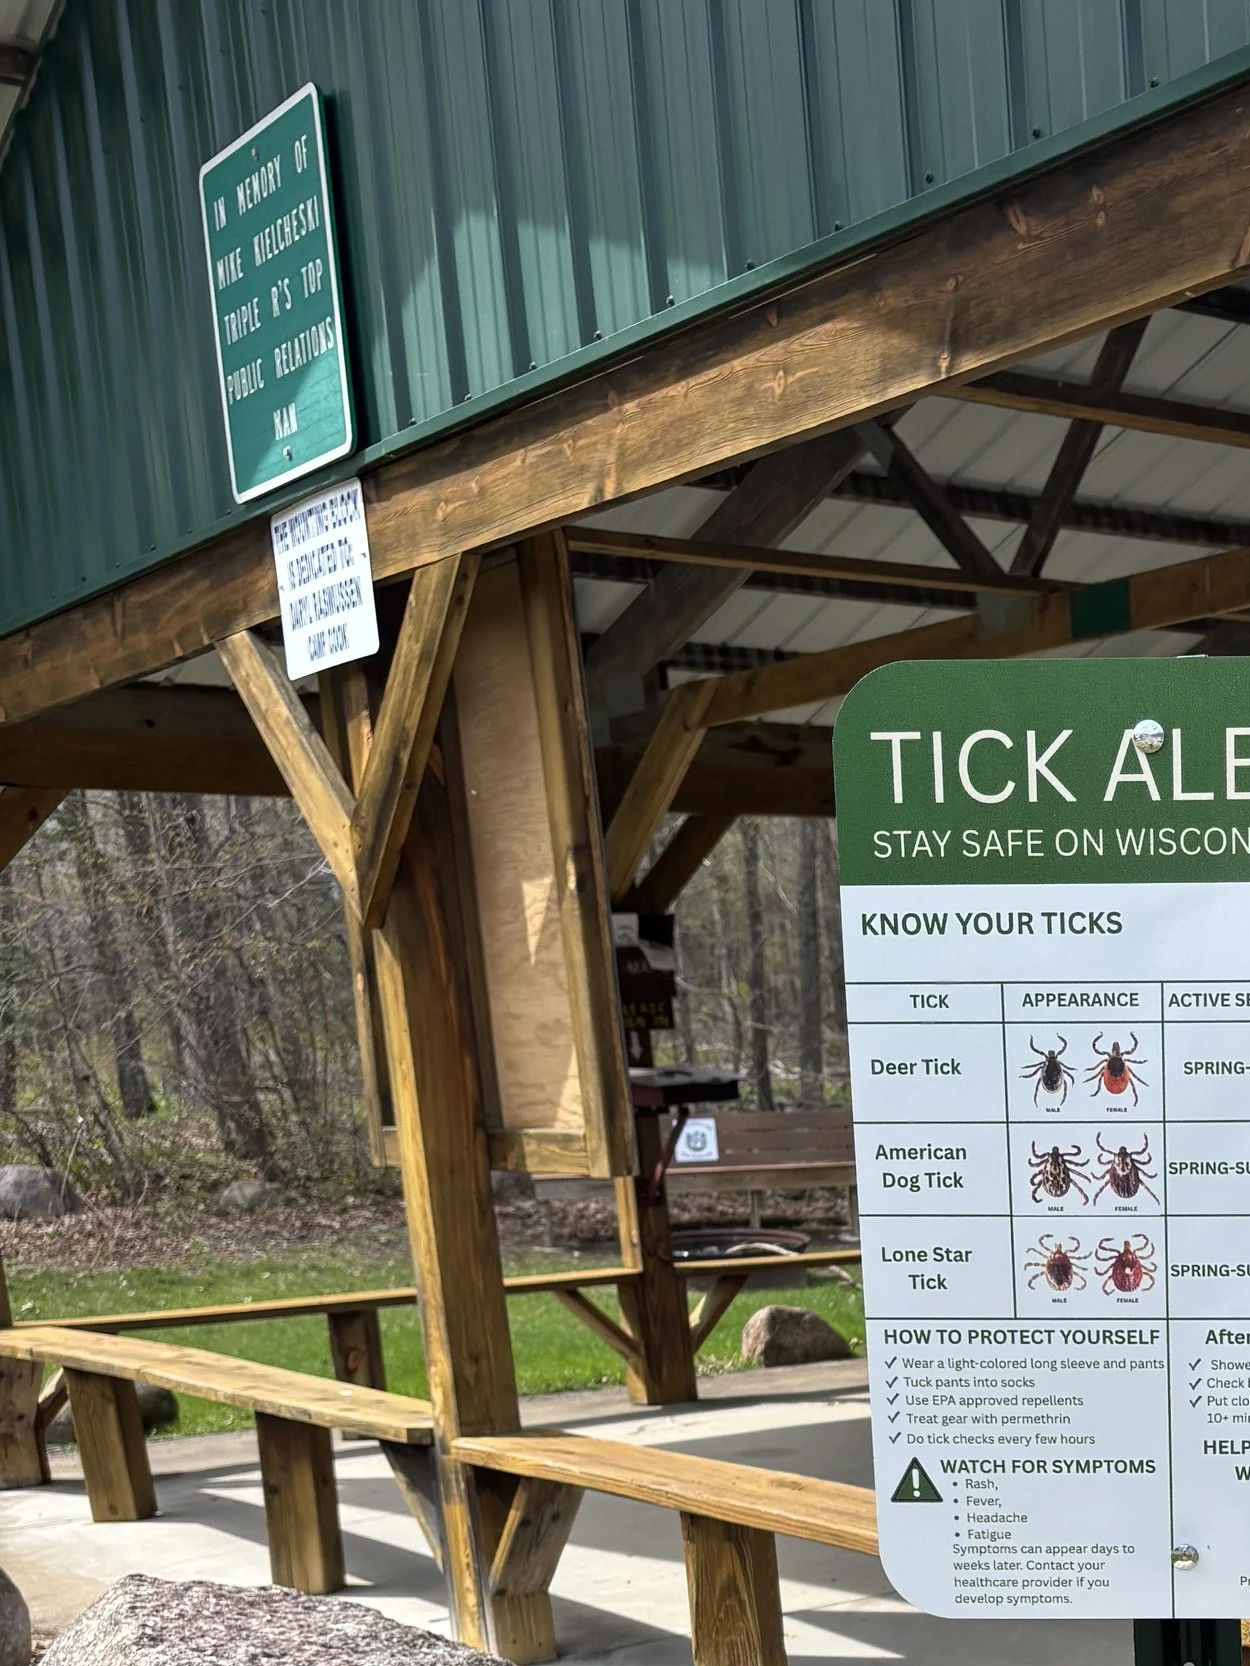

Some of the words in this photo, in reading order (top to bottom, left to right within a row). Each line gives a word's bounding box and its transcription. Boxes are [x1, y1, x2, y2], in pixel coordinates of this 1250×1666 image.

[214, 196, 227, 231] IN
[236, 154, 281, 216] MEMORY
[294, 134, 308, 174] OF
[216, 247, 243, 290] MIKE
[252, 195, 320, 267] KIELCHESKI
[224, 297, 261, 345] TRIPLE
[300, 258, 323, 298] TOP
[226, 358, 265, 405] PUBLIC
[274, 316, 335, 379] RELATIONS
[273, 402, 298, 440] MAN
[869, 729, 1078, 804] TICK
[873, 829, 952, 859] STAY
[962, 829, 1045, 858] SAFE
[1055, 828, 1104, 857] ON
[861, 912, 949, 936] KNOW
[954, 911, 1035, 936] YOUR
[1040, 911, 1123, 935] TICKS
[909, 993, 950, 1009] TICK
[1021, 992, 1140, 1008] APPEARANCE
[1167, 992, 1231, 1008] ACTIVE
[870, 1058, 918, 1076] Deer
[920, 1057, 962, 1076] Tick
[874, 1143, 967, 1161] American
[882, 1172, 921, 1193] Dog
[923, 1171, 965, 1189] Tick
[881, 1246, 928, 1263] Lone
[932, 1246, 973, 1263] Star
[907, 1273, 948, 1290] Tick
[883, 1328, 932, 1345] HOW
[935, 1329, 962, 1345] TO
[967, 1329, 1056, 1345] PROTECT
[1059, 1329, 1161, 1345] YOURSELF
[901, 1357, 935, 1369] Wear
[937, 1359, 946, 1369] a
[947, 1357, 1028, 1372] light-colored
[1030, 1357, 1058, 1372] long
[1060, 1357, 1101, 1370] sleeve
[1102, 1357, 1127, 1370] and
[1129, 1359, 1165, 1372] pants
[902, 1376, 933, 1388] Tuck
[935, 1377, 971, 1391] pants
[973, 1376, 998, 1388] into
[1000, 1376, 1036, 1388] socks
[1206, 1377, 1245, 1389] Check
[905, 1394, 930, 1406] Use
[932, 1394, 957, 1406] EPA
[958, 1394, 1019, 1409] approved
[1021, 1394, 1084, 1409] repellents
[1207, 1395, 1229, 1407] Put
[905, 1413, 939, 1425] Treat
[941, 1415, 969, 1427] gear
[970, 1412, 998, 1425] with
[1000, 1413, 1071, 1427] permethrin
[1207, 1412, 1229, 1424] 10+
[906, 1433, 925, 1445] Do
[926, 1432, 951, 1445] tick
[952, 1433, 995, 1445] checks
[997, 1435, 1033, 1448] every
[1034, 1432, 1058, 1445] few
[1060, 1433, 1096, 1445] hours
[939, 1459, 1006, 1474] WATCH
[1011, 1459, 1048, 1474] FOR
[1051, 1459, 1157, 1474] SYMPTOMS
[965, 1478, 999, 1491] Rash,
[966, 1495, 1002, 1509] Fever,
[966, 1511, 1028, 1524] Headache
[967, 1528, 1012, 1543] Fatigue
[952, 1543, 1018, 1557] Symptoms
[1020, 1545, 1043, 1554] can
[1045, 1545, 1089, 1557] appear
[1090, 1543, 1120, 1557] days
[1121, 1544, 1136, 1554] to
[952, 1559, 991, 1571] weeks
[992, 1559, 1024, 1571] later.
[1025, 1559, 1075, 1571] Contact
[1077, 1561, 1106, 1574] your
[954, 1576, 1019, 1588] healthcare
[1021, 1576, 1074, 1590] provider
[1076, 1576, 1086, 1588] if
[1087, 1579, 1110, 1590] you
[954, 1593, 1004, 1607] develop
[1006, 1594, 1073, 1607] symptoms.
